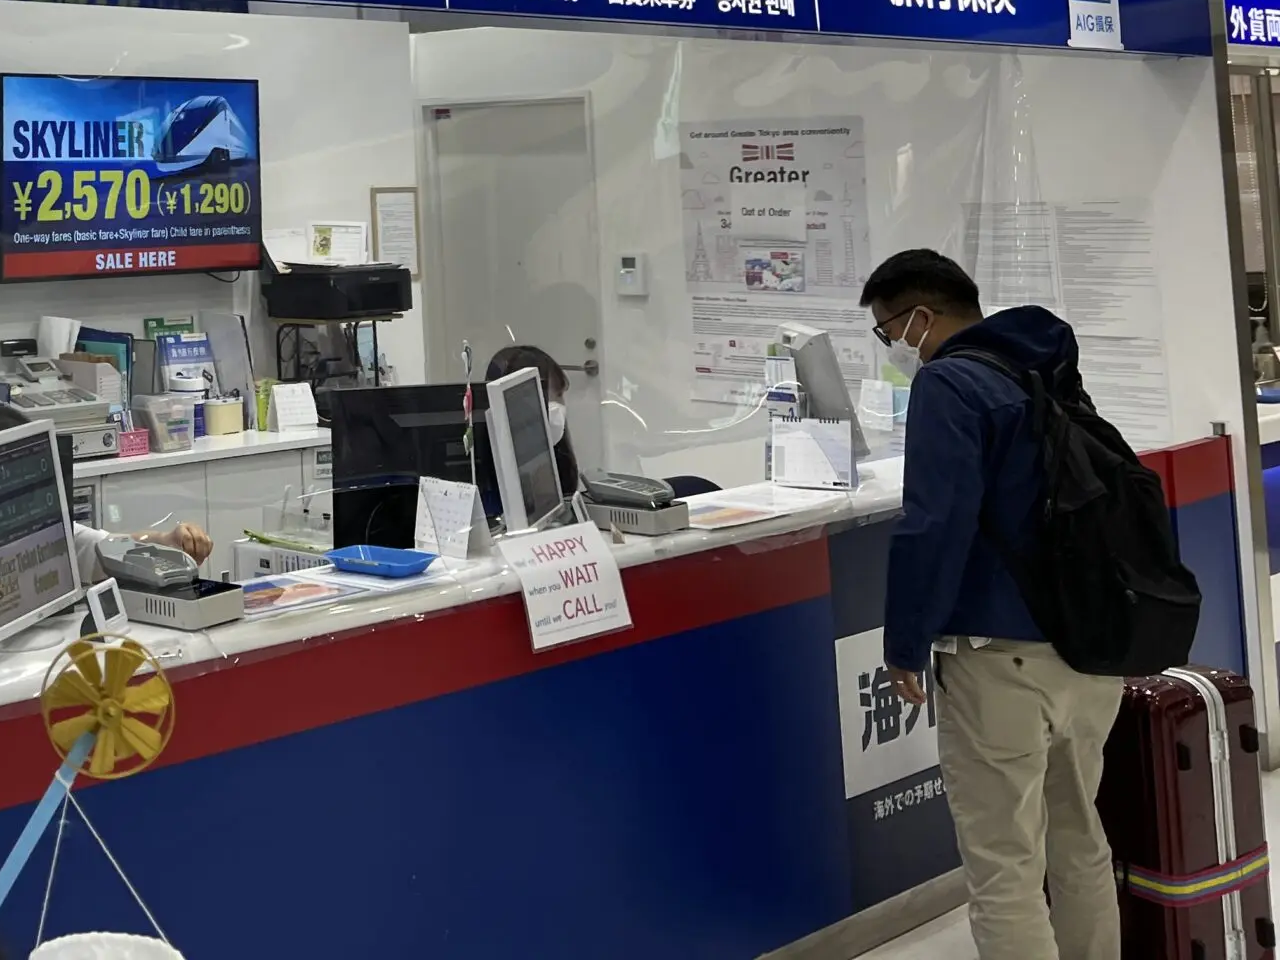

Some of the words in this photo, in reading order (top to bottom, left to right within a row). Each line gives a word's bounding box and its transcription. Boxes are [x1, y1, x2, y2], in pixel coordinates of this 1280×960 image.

[1076, 14, 1114, 33] AIG損保
[12, 120, 145, 159] SKYLINER
[729, 166, 810, 183] Greater
[13, 169, 151, 222] ¥2,570
[157, 181, 251, 217] (¥1,290)
[741, 207, 755, 217] Out
[757, 207, 766, 217] of
[768, 207, 791, 217] Order
[13, 232, 50, 244] One-way
[51, 231, 72, 241] fares
[73, 230, 97, 243] (basic
[98, 228, 150, 242] fare+Skyliner
[151, 227, 169, 239] fare)
[170, 226, 188, 237] Child
[189, 227, 203, 237] fare
[204, 227, 211, 236] in
[95, 252, 133, 271] SALE
[139, 250, 176, 268] HERE
[531, 535, 588, 563] HAPPY
[528, 584, 548, 596] when
[548, 583, 561, 593] you
[558, 562, 600, 589] WAIT
[562, 594, 603, 620] CALL
[873, 777, 948, 820] 海外での予期せ
